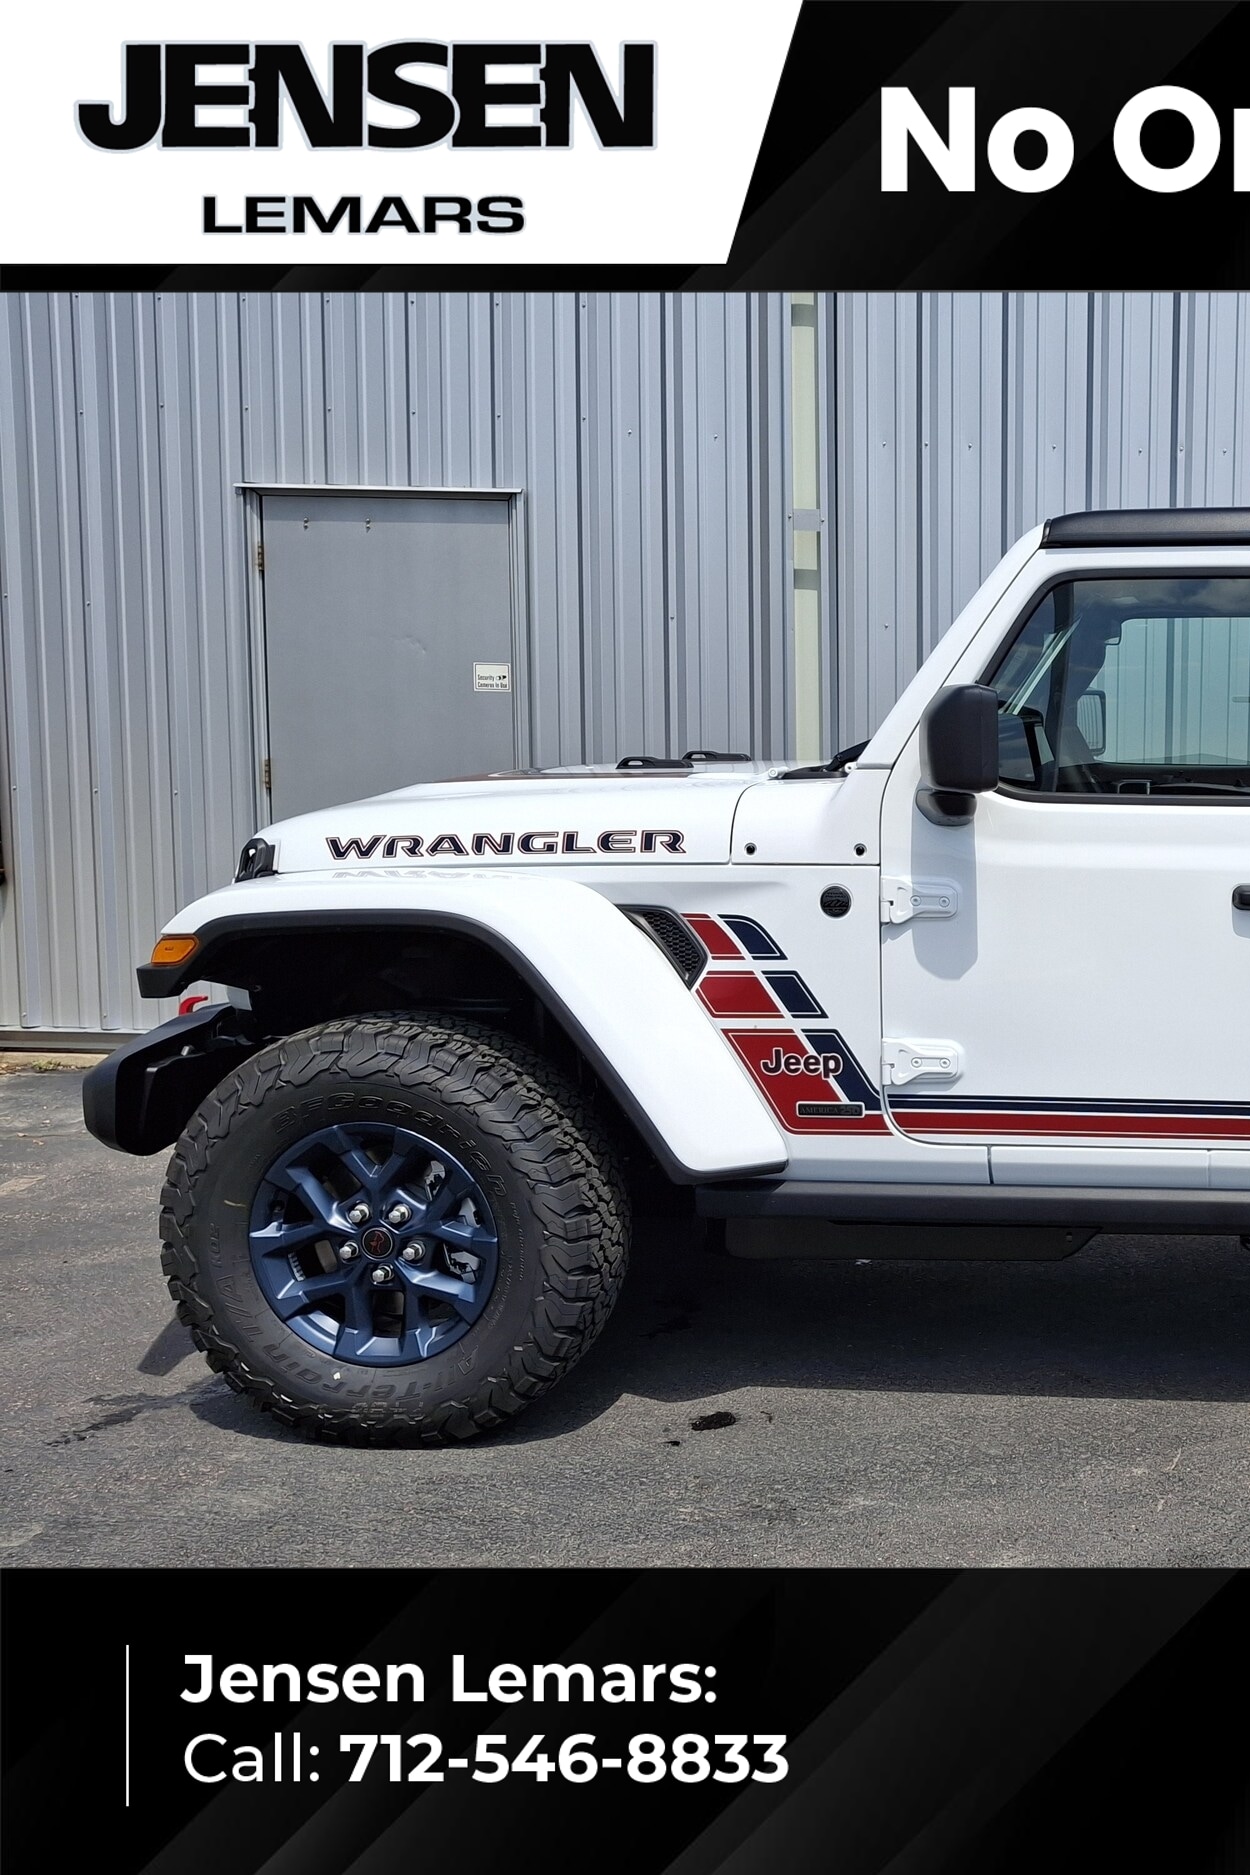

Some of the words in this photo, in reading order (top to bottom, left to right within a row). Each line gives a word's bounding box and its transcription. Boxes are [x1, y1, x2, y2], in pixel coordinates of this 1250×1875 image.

[477, 674, 495, 682] Security
[325, 829, 687, 861] WRANGLER
[760, 1047, 843, 1081] Jeep
[799, 1105, 838, 1115] AMERICA
[273, 1092, 509, 1197] BFGoodrich
